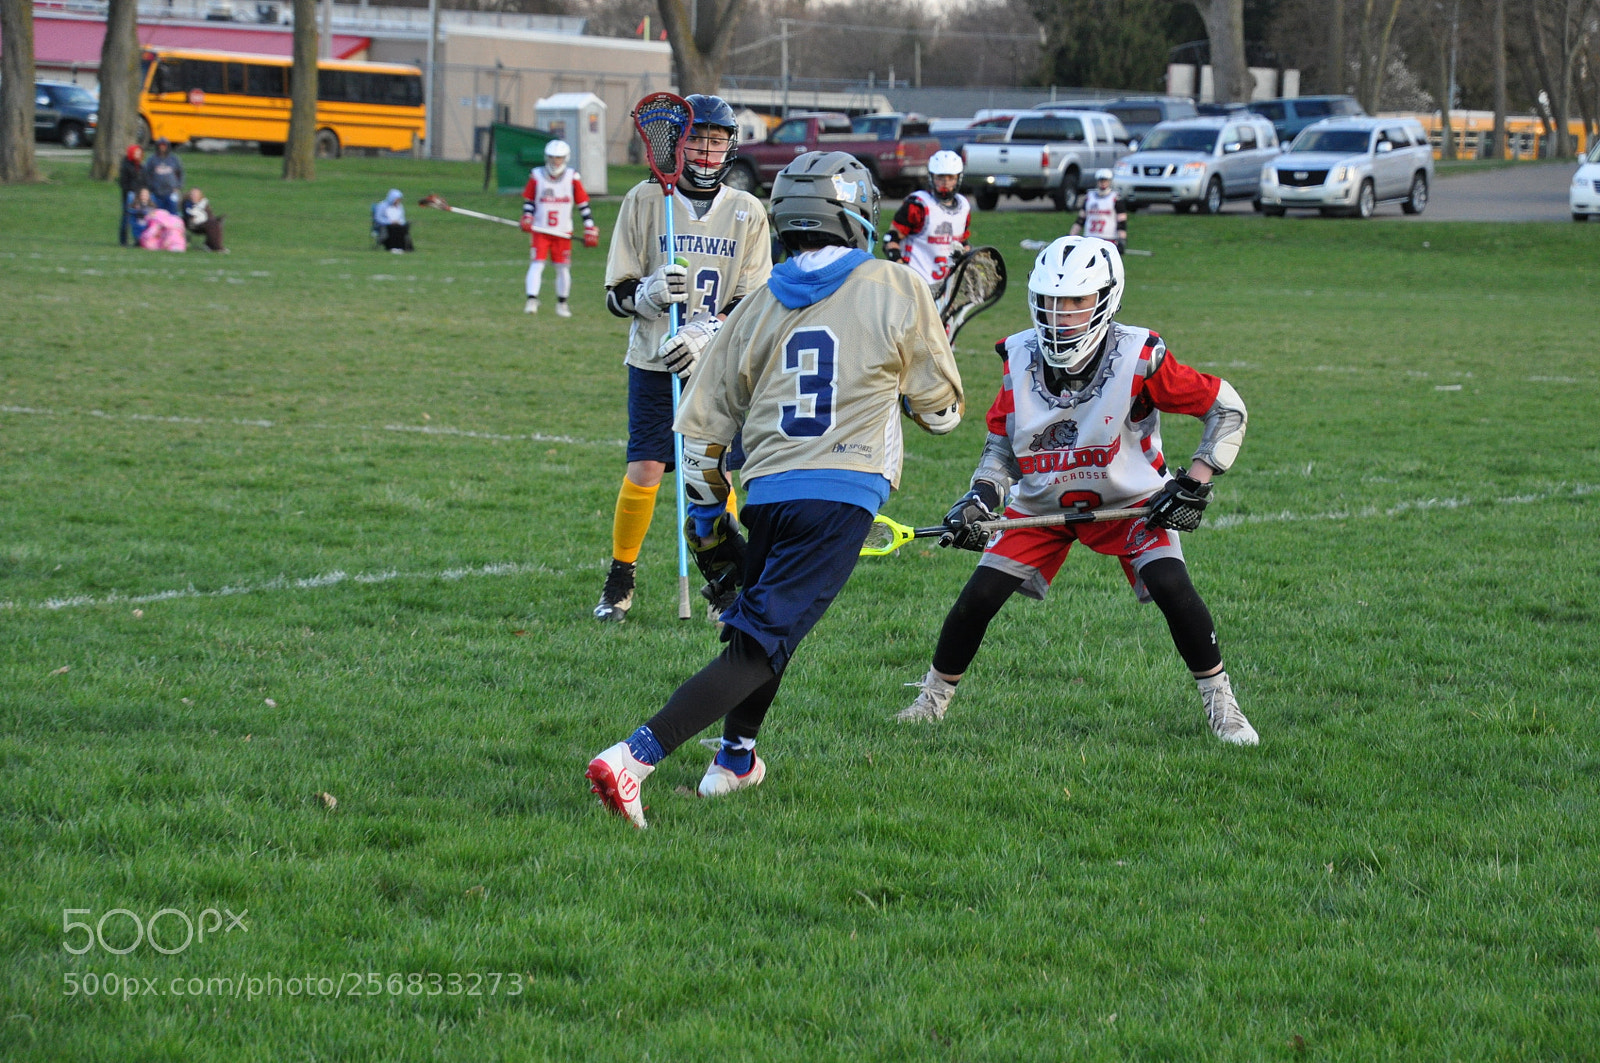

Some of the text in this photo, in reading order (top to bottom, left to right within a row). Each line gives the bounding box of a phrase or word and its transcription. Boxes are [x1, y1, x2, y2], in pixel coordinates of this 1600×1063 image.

[547, 210, 559, 227] 5
[931, 256, 951, 280] 3
[777, 325, 839, 440] 3
[1048, 471, 1108, 485] ACROSSE
